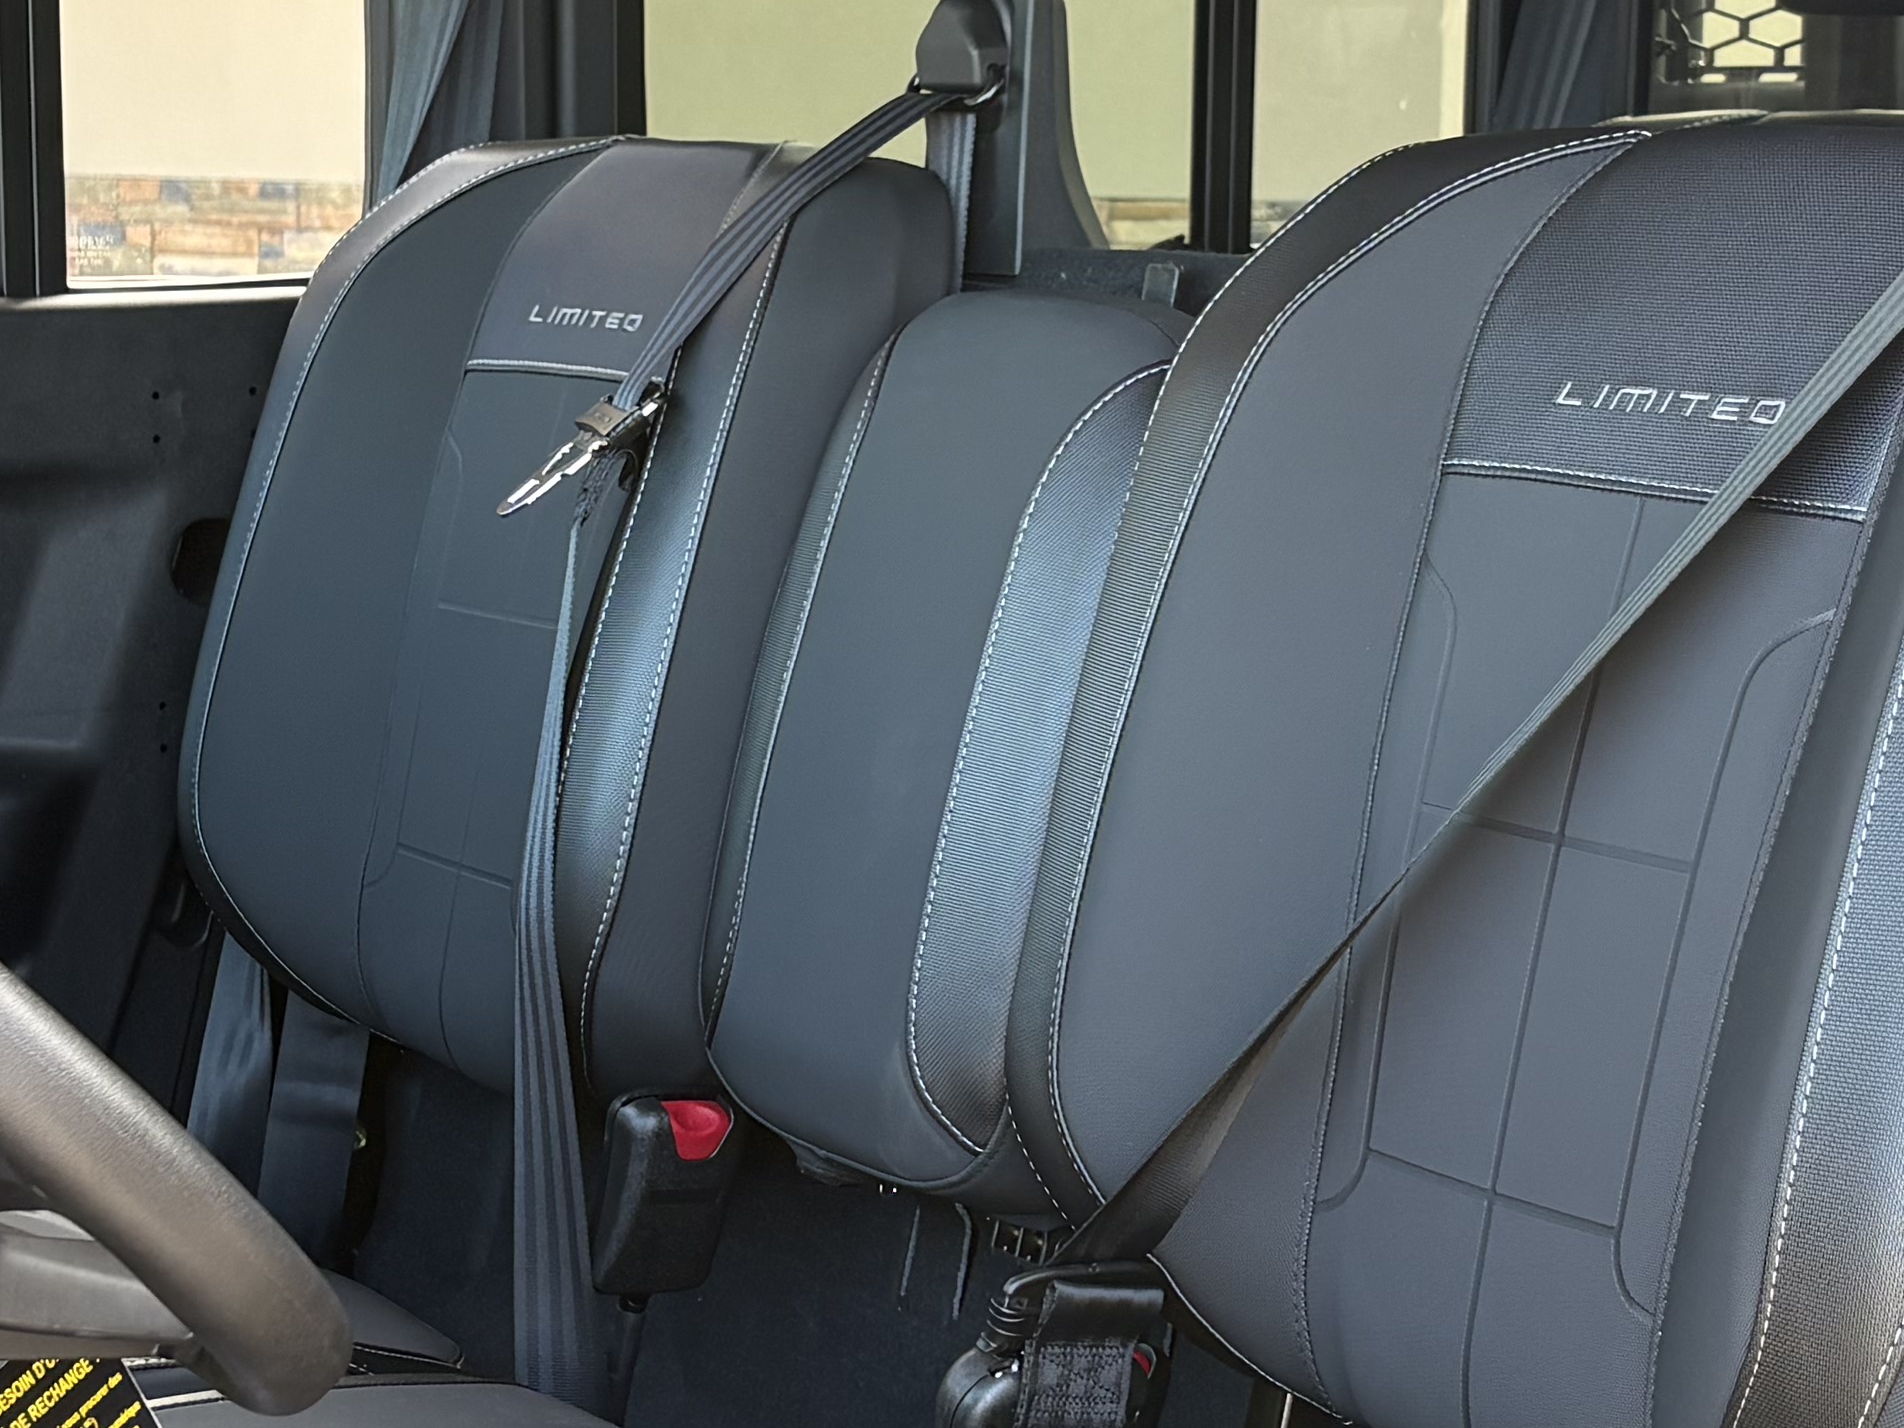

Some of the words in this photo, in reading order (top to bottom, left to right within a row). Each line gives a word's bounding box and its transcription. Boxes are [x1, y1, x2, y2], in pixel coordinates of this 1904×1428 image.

[527, 303, 645, 332] LIMITED
[1553, 380, 1787, 426] LIMITED
[32, 1358, 59, 1379] D'U
[27, 1358, 94, 1422] RECHANGE
